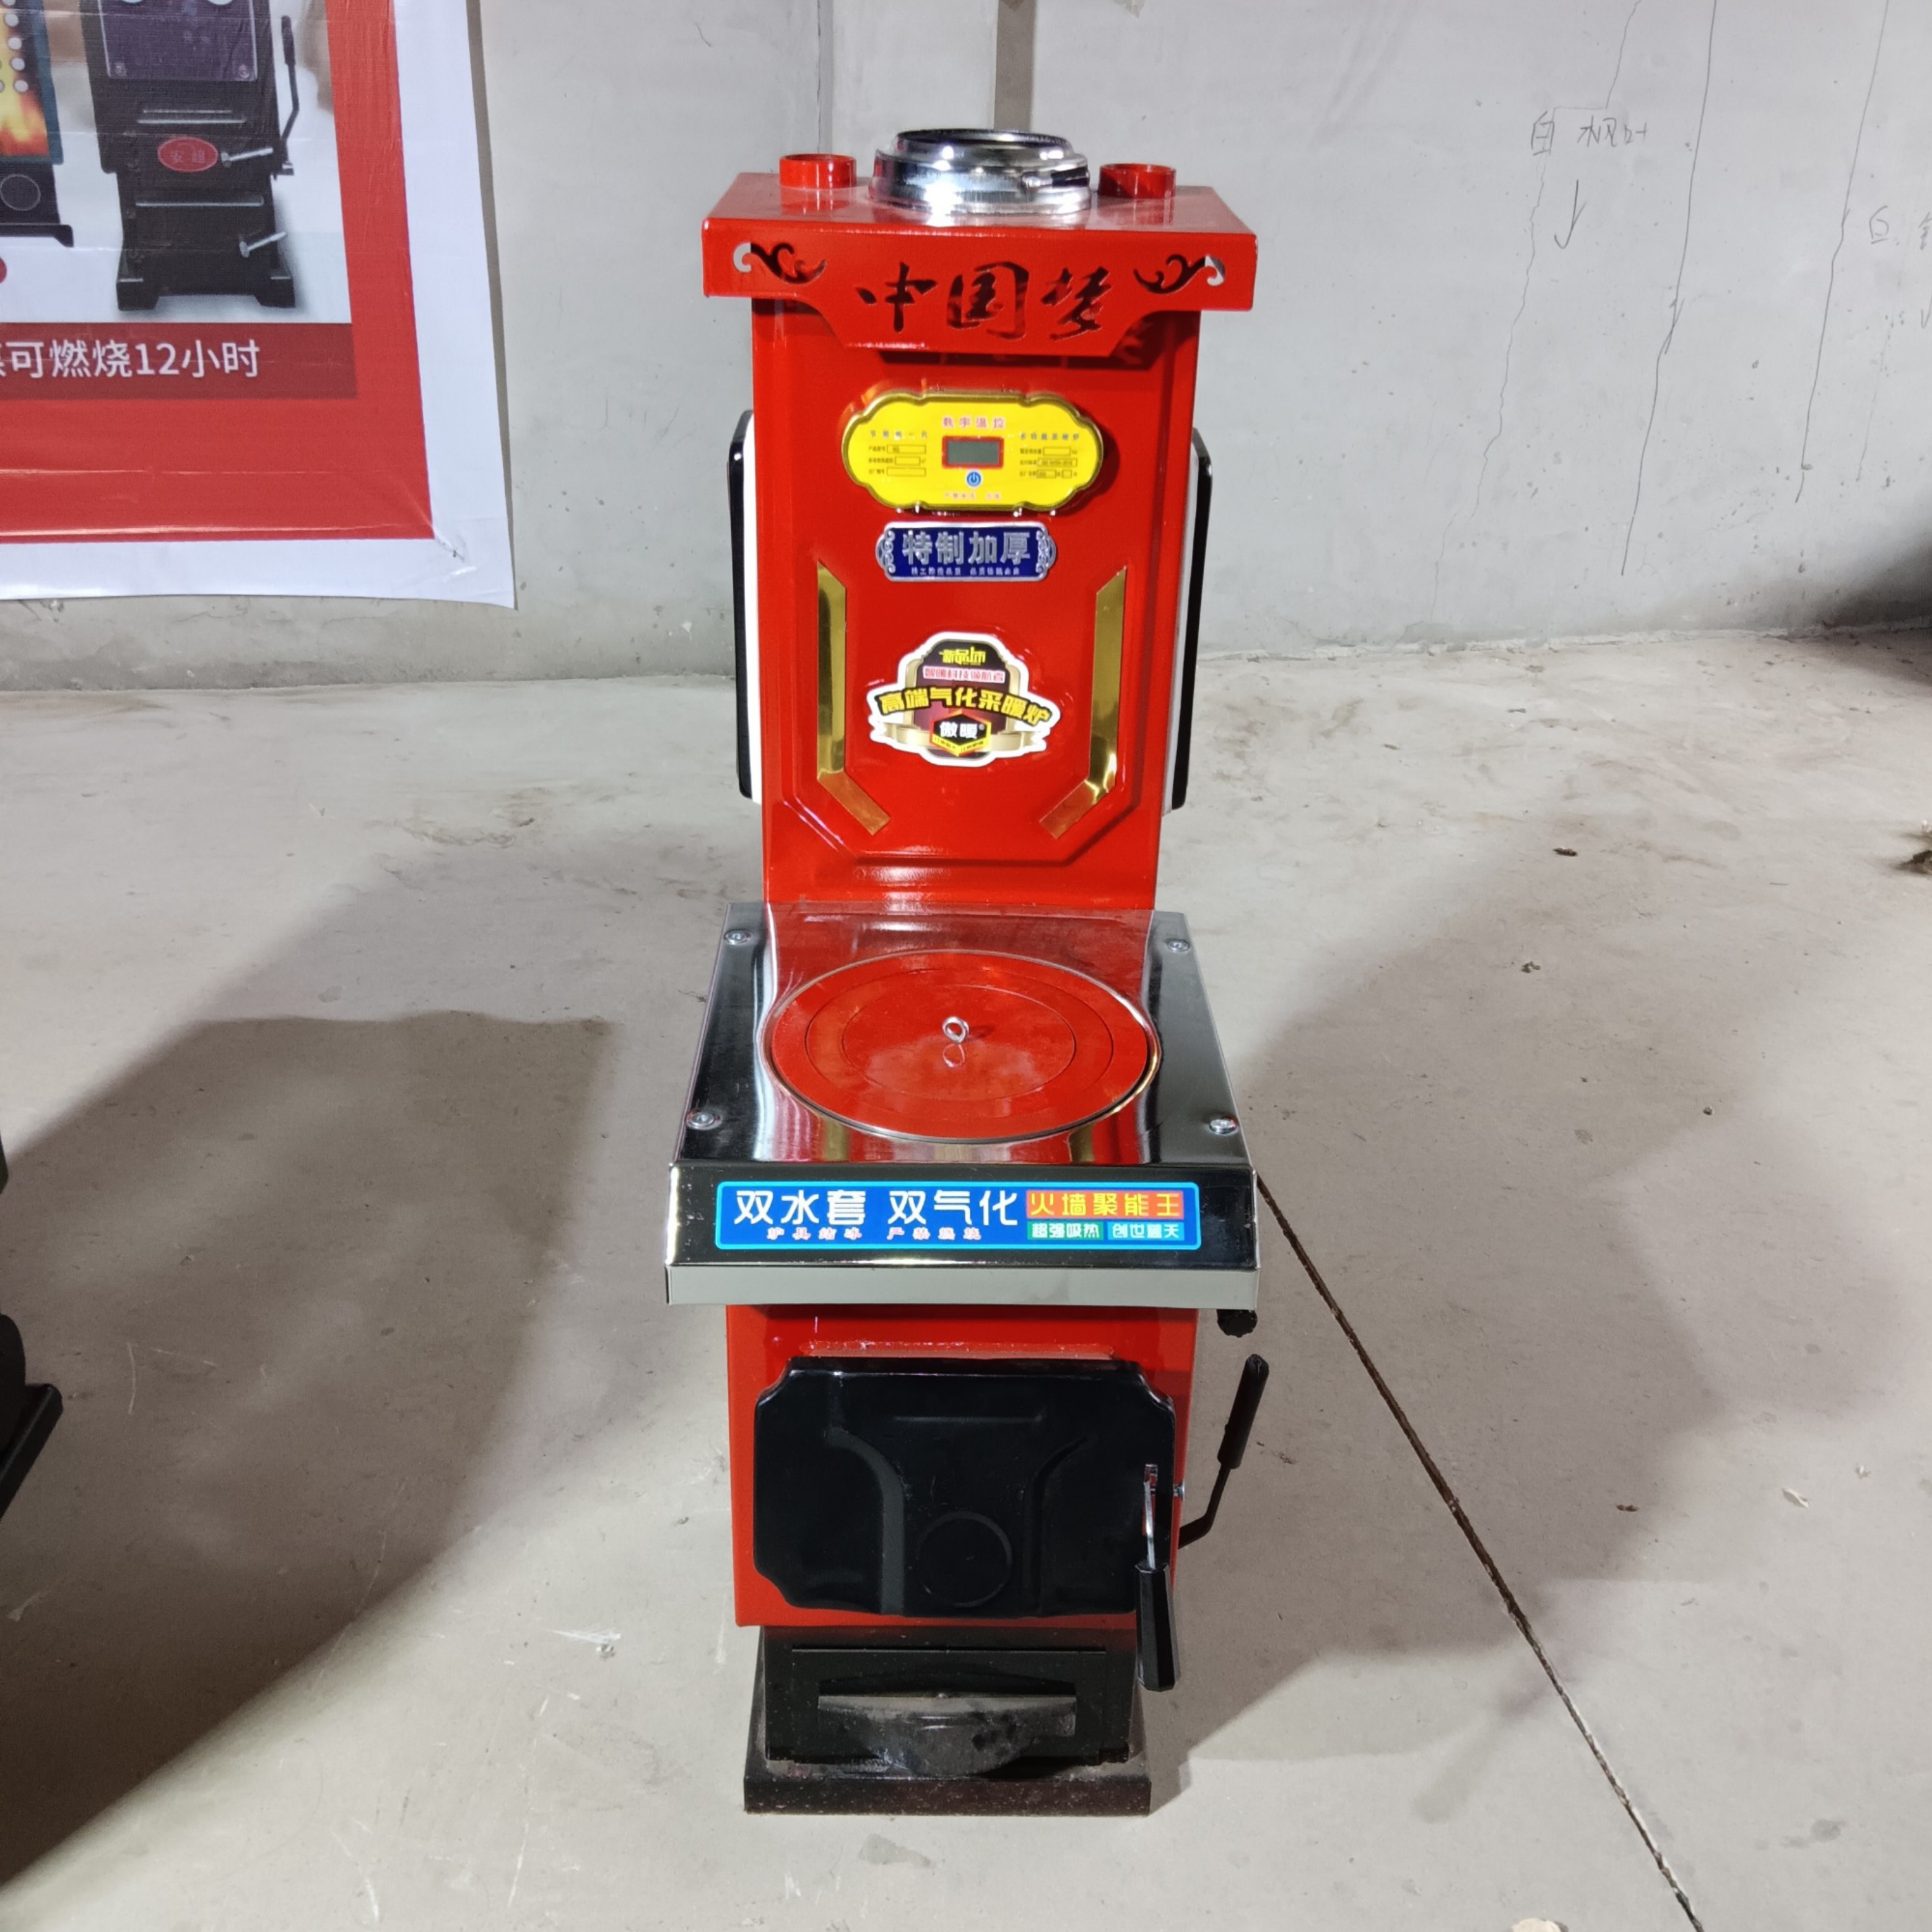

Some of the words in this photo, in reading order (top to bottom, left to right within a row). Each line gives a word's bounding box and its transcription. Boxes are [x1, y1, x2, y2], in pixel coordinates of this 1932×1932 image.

[855, 261, 1112, 341] 中国梦
[902, 530, 1031, 565] 特制加厚
[877, 687, 1051, 726] 高端气化采暖炉
[734, 1190, 866, 1225] 双水套
[887, 1190, 1019, 1226] 双气化
[1030, 1192, 1180, 1217] 火墙聚能王
[1031, 1222, 1100, 1238] 超强吸热
[1112, 1223, 1180, 1238] 创世蓝天
